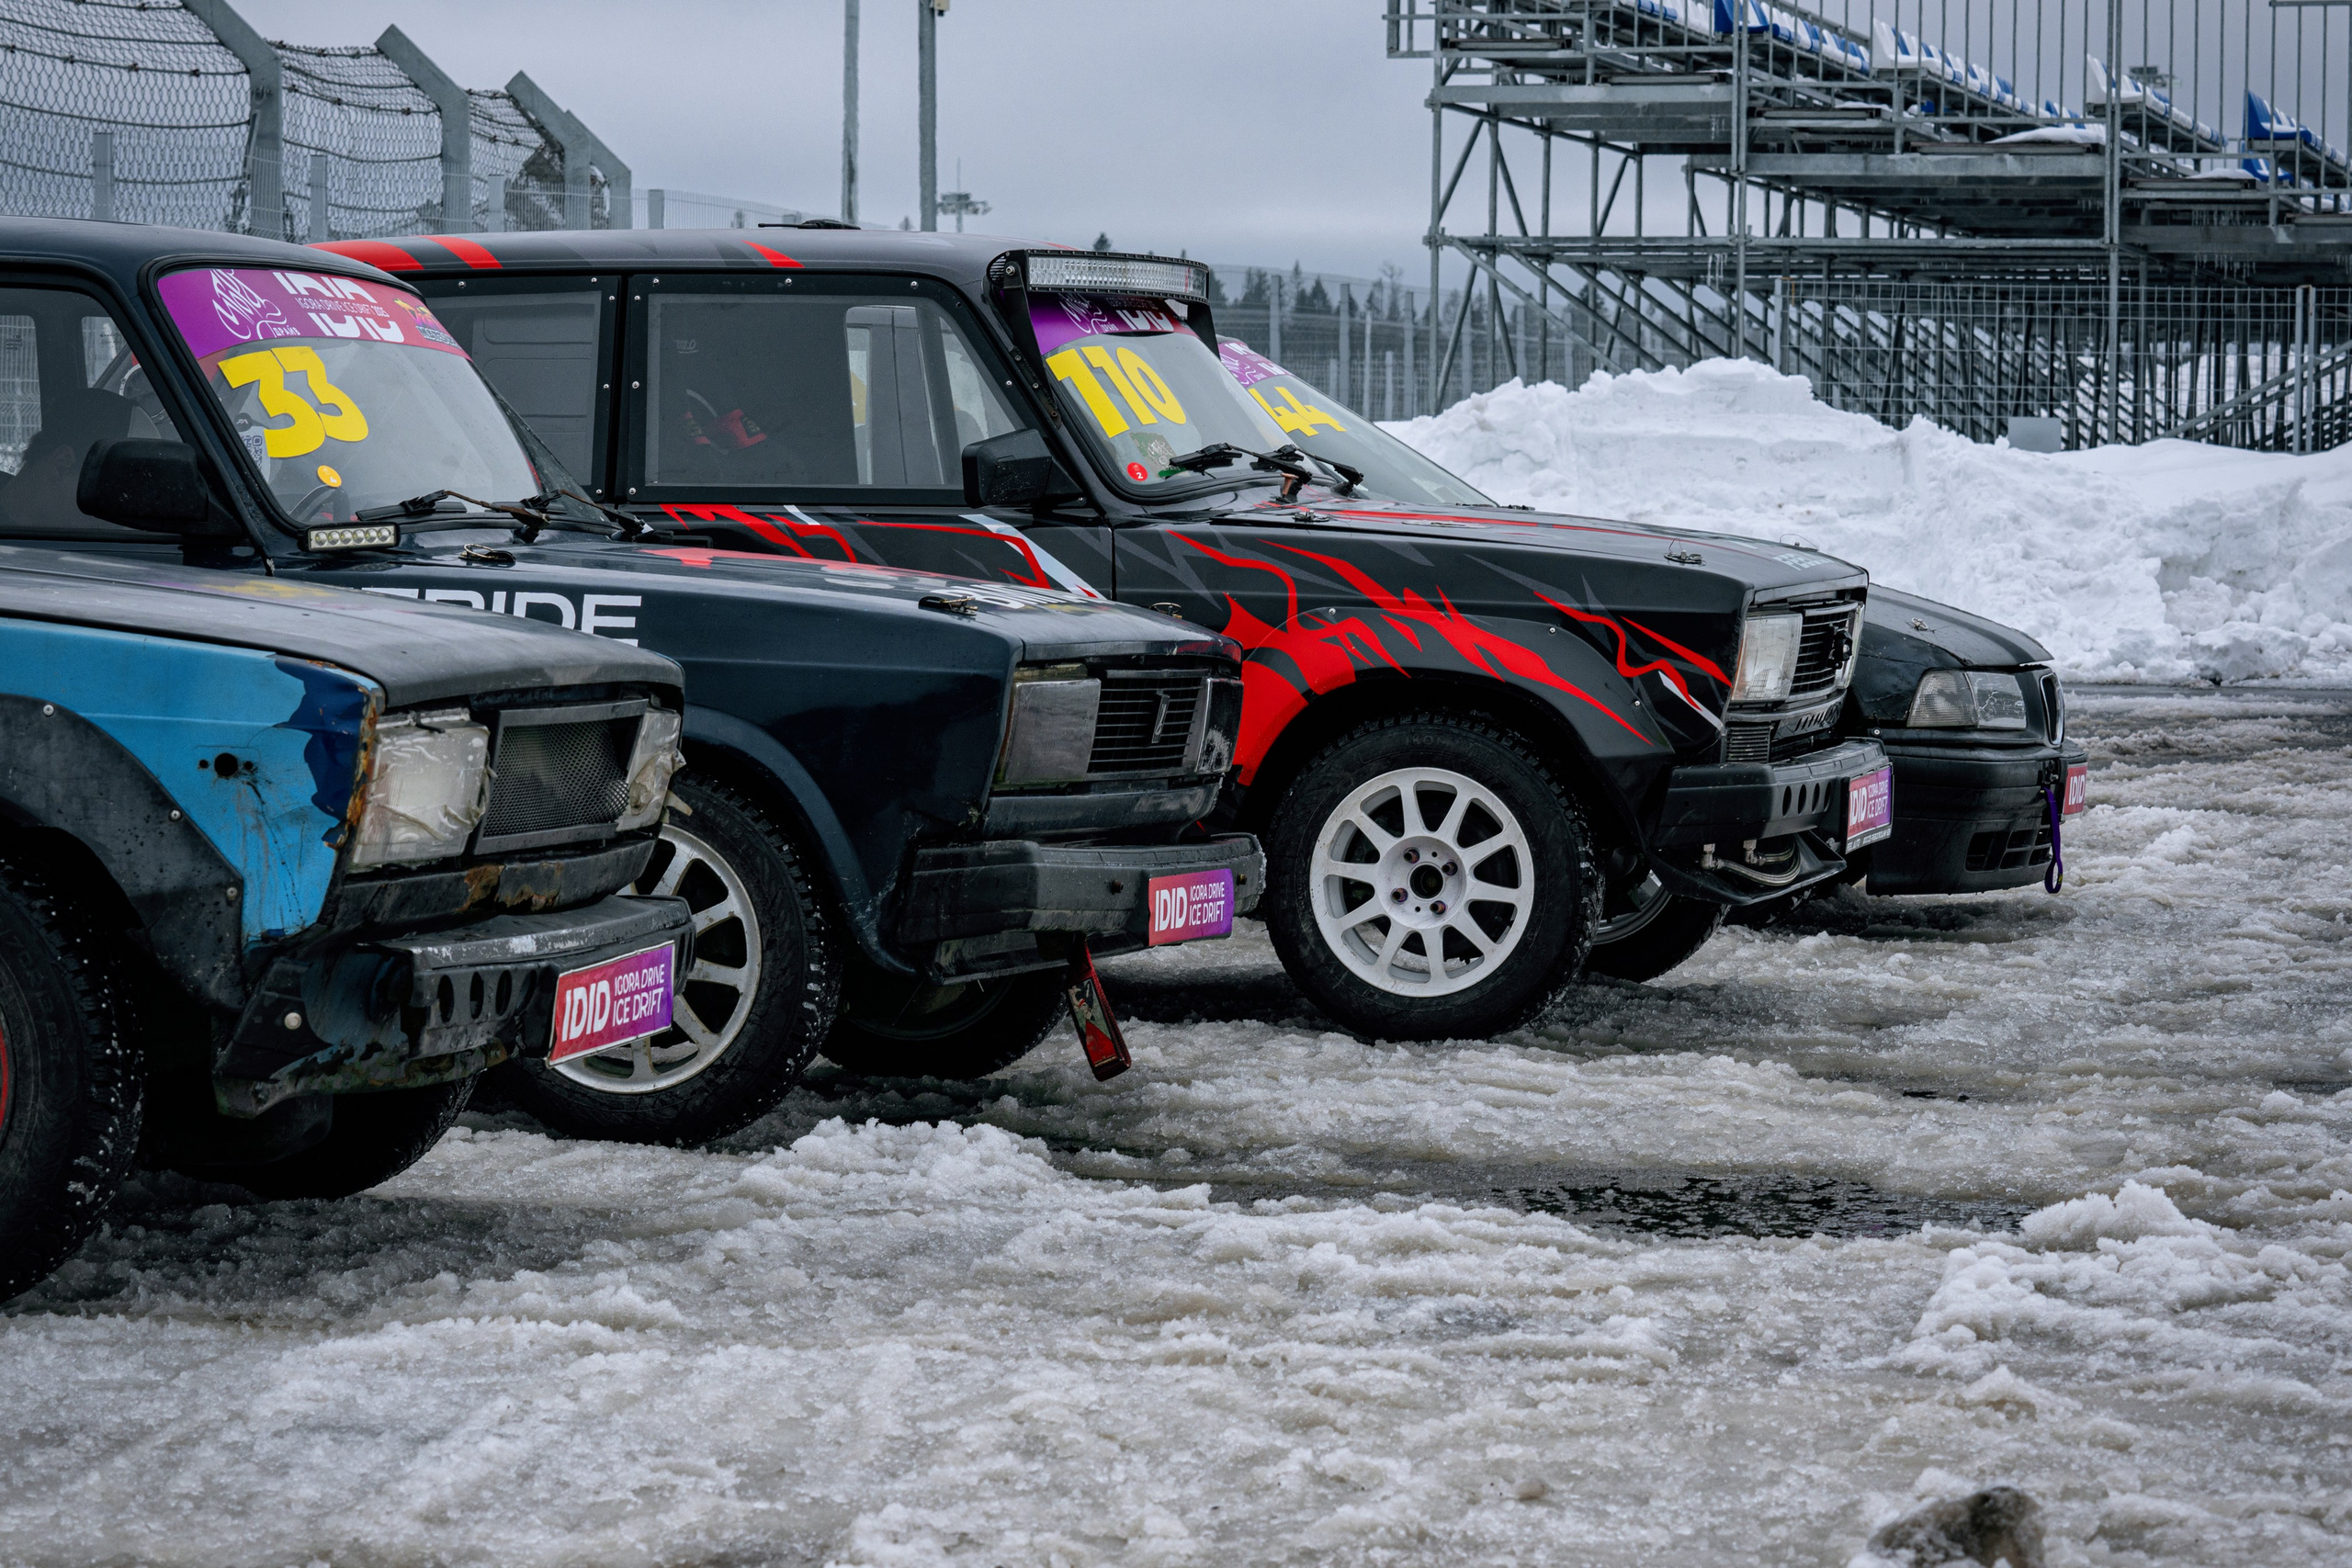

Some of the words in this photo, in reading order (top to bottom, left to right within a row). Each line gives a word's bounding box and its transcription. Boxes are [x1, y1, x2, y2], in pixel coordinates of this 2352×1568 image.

[294, 297, 324, 310] IGORA
[320, 299, 347, 312] DRIVE
[352, 303, 376, 316] DRIFT
[217, 345, 369, 458] 33
[1046, 345, 1187, 439] 110
[1248, 386, 1348, 437] 44
[1849, 786, 1869, 827] IDID
[1867, 799, 1875, 820] ICE
[1874, 795, 1889, 818] DRIFT
[2069, 774, 2086, 806] IDID
[1155, 887, 1188, 931] IDID
[1190, 885, 1208, 902] IGORA
[1207, 881, 1226, 899] DRIVE
[1188, 903, 1203, 926] ICE
[1203, 900, 1225, 924] DRIFT
[614, 972, 641, 997] IGORA
[640, 963, 665, 989] DRIVE
[561, 979, 611, 1043] IDID
[612, 996, 630, 1027] ICE
[631, 987, 665, 1021] DRIFT
